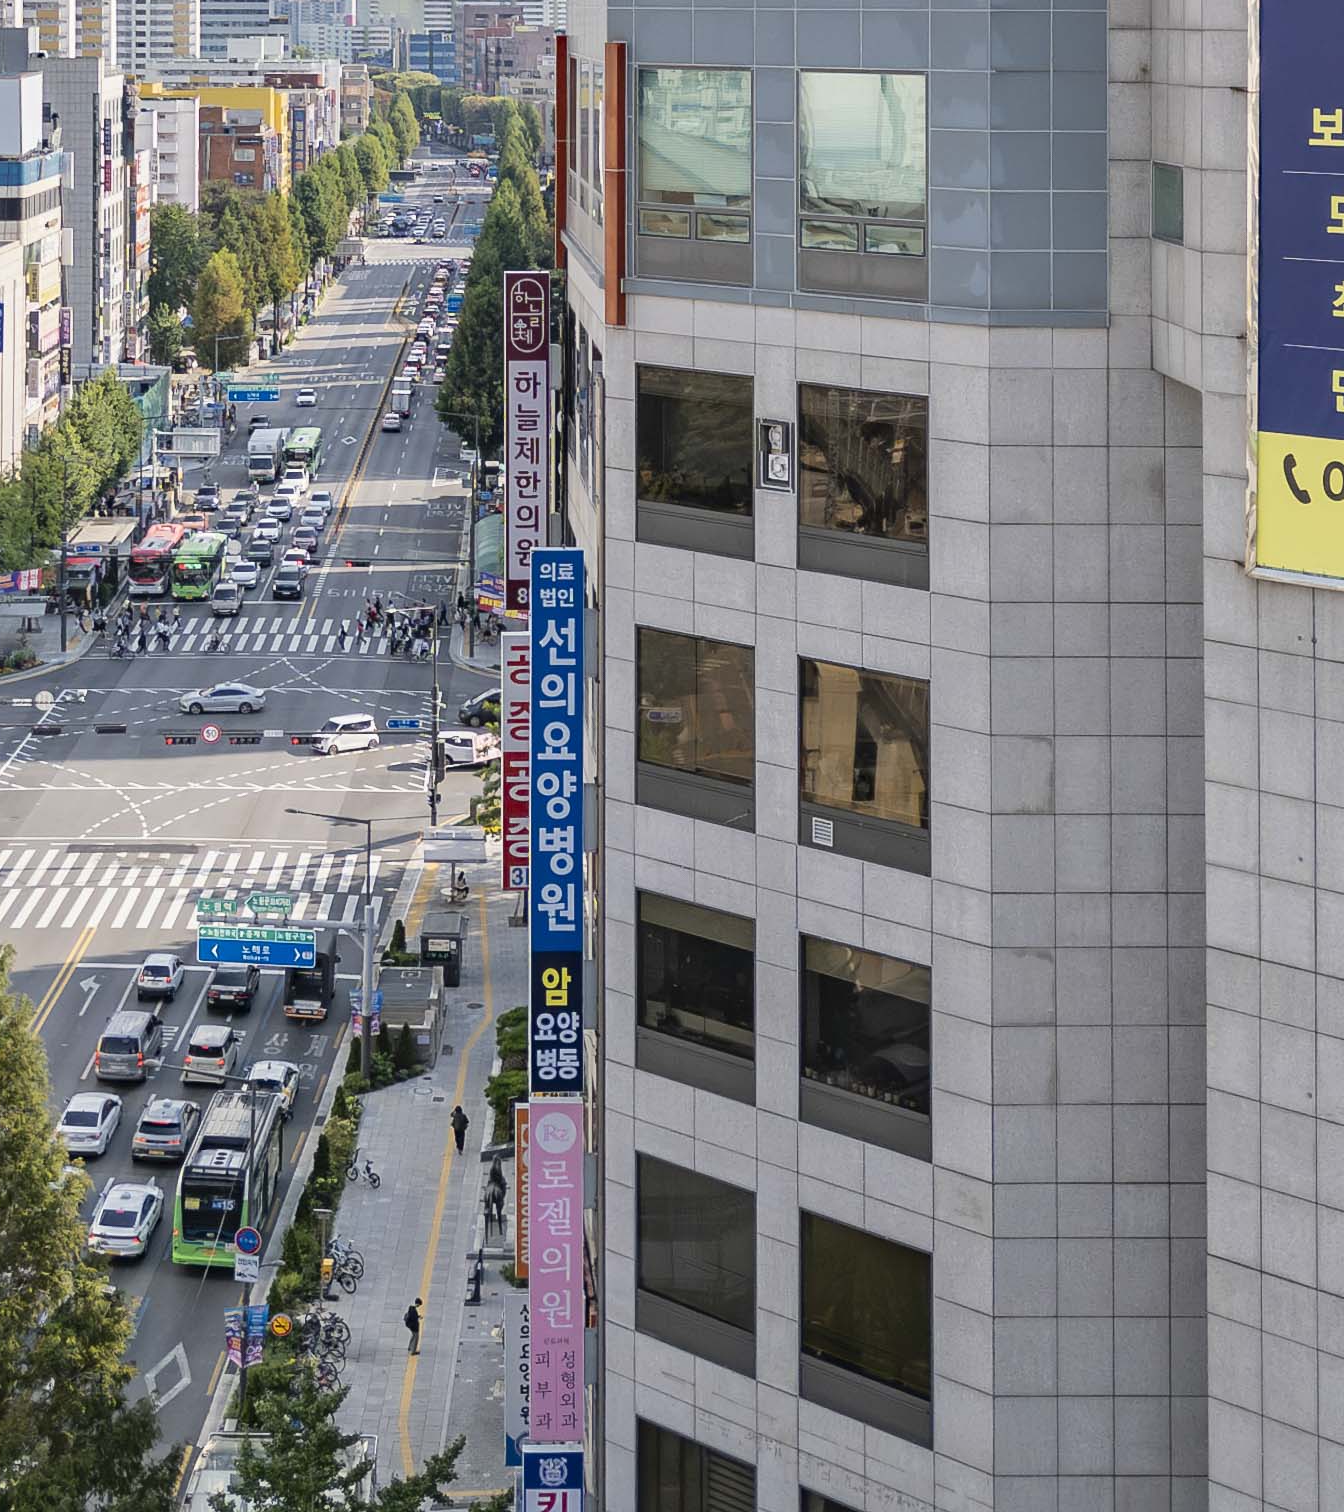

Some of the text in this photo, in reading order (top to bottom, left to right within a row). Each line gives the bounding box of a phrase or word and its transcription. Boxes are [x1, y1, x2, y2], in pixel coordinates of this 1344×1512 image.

[513, 371, 541, 569] 하늘체한의원
[539, 562, 575, 581] 의료
[539, 588, 575, 607] 법인
[536, 617, 577, 932] 선의요양병원
[542, 967, 572, 1007] 암
[534, 1011, 580, 1044] 요양
[536, 1048, 580, 1080] 병동
[535, 1350, 552, 1430] 피부과
[560, 1350, 578, 1430] 성형외과
